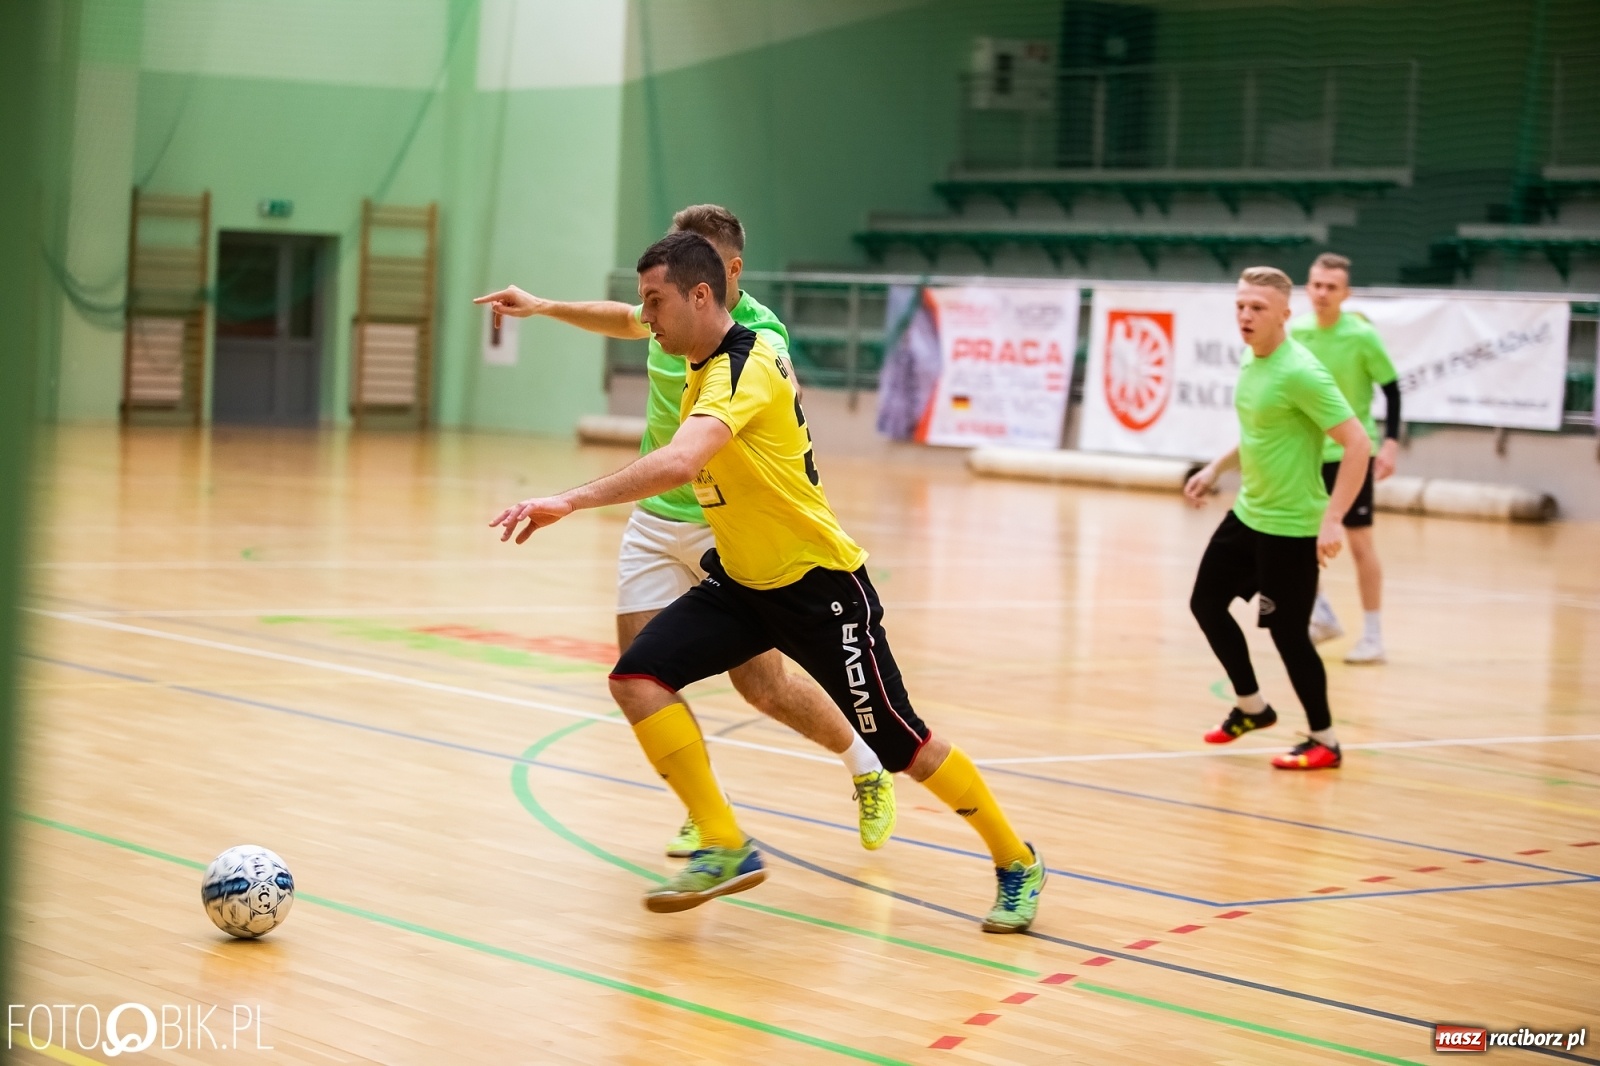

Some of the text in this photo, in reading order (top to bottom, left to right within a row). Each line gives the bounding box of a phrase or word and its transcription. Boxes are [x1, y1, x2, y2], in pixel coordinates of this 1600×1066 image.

[951, 336, 1064, 366] PRACA
[830, 601, 844, 616] 9
[842, 622, 878, 734] GIVOVA
